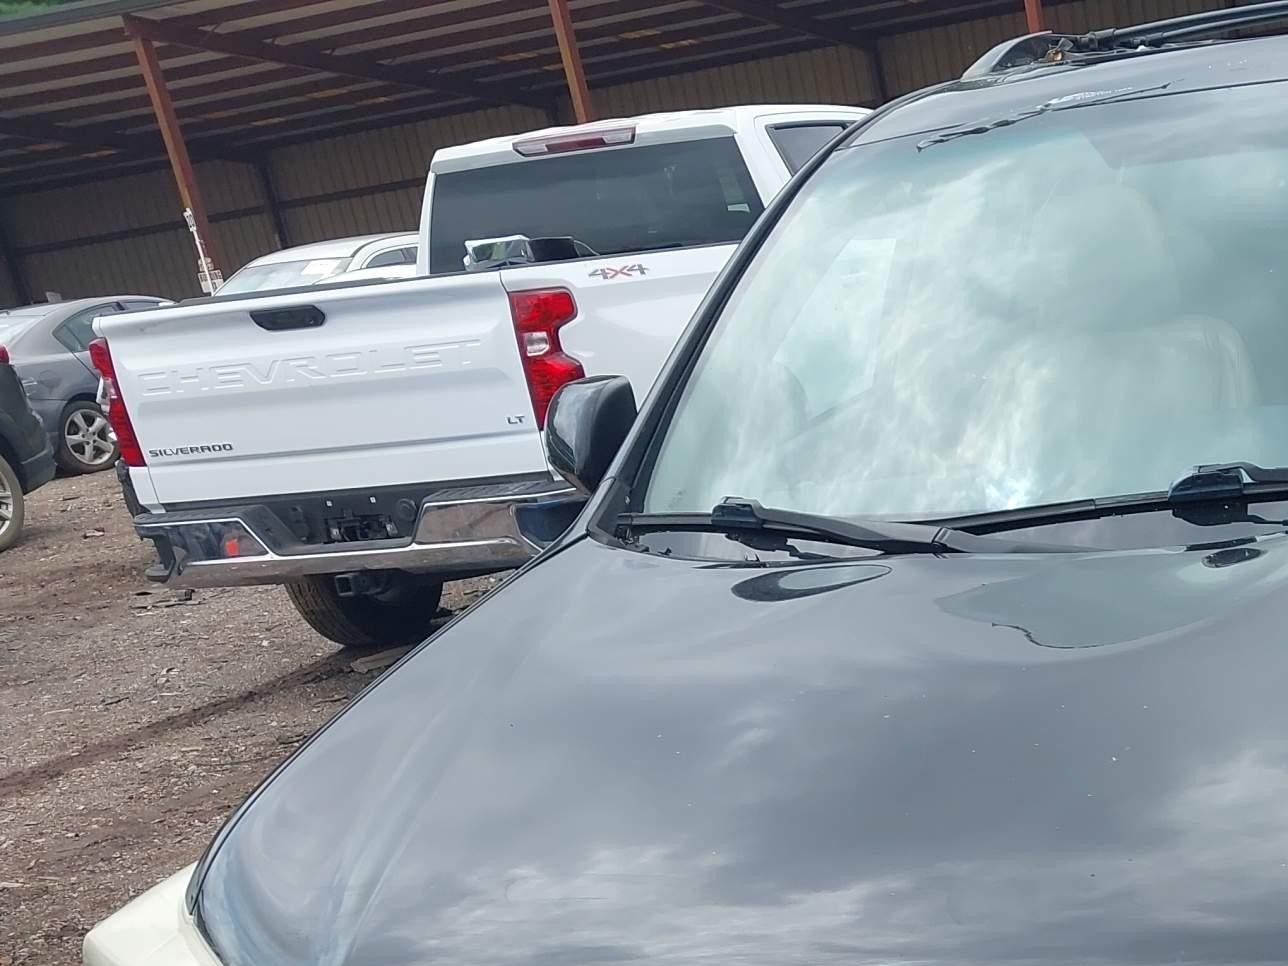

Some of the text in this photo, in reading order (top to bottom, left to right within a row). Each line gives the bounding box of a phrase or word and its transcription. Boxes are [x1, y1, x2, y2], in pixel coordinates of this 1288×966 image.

[138, 338, 483, 397] CHEVROLET
[506, 414, 526, 425] LT
[148, 442, 233, 458] SILVERADO
